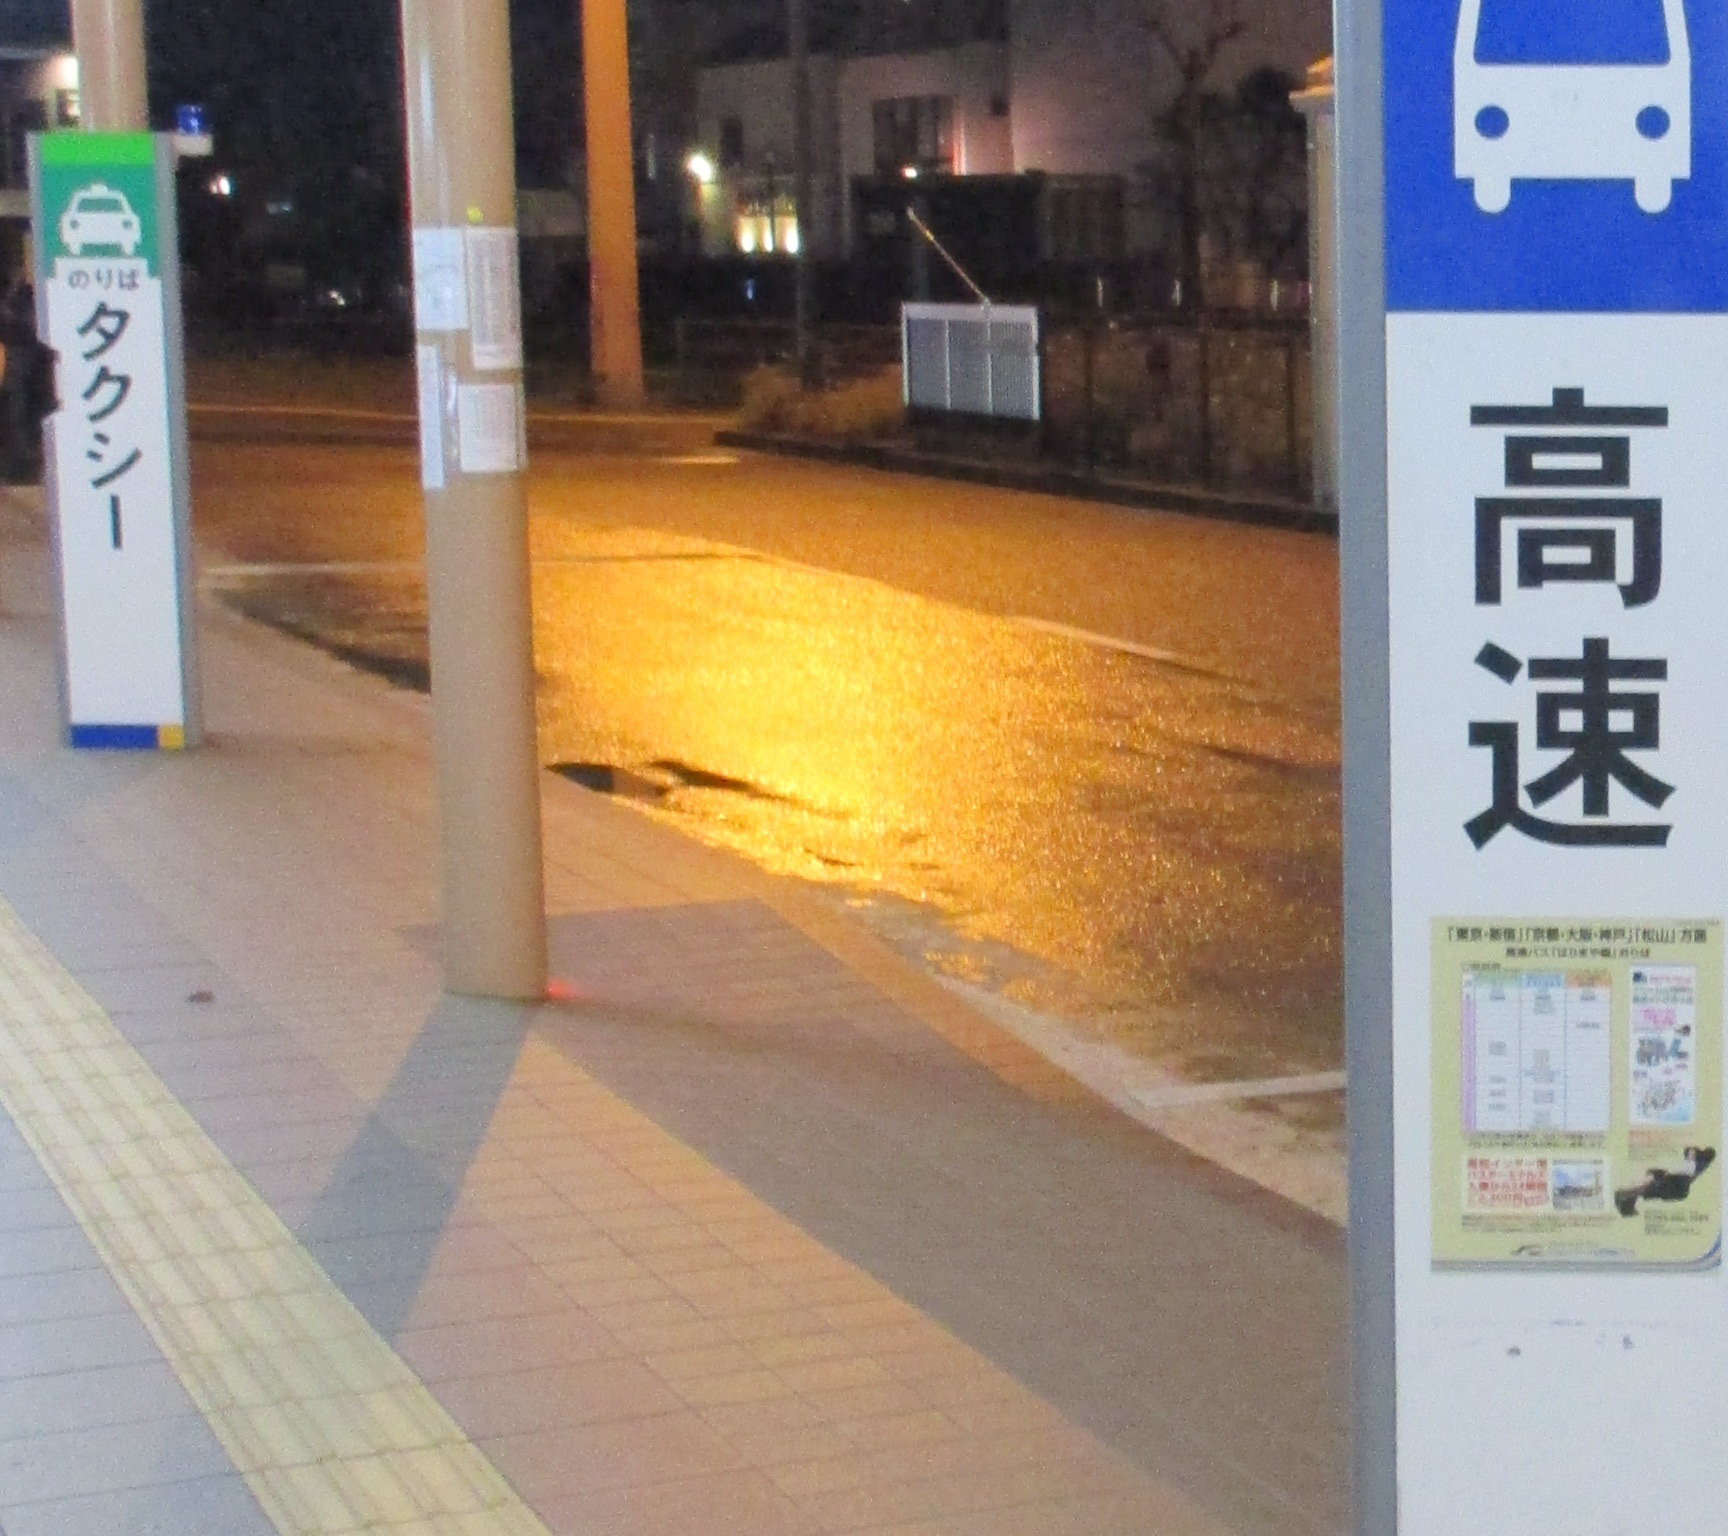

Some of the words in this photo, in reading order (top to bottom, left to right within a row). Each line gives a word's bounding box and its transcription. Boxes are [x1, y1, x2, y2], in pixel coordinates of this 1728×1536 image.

[68, 267, 140, 292] のりば
[77, 301, 143, 550] タクシー
[1463, 387, 1677, 851] 高速
